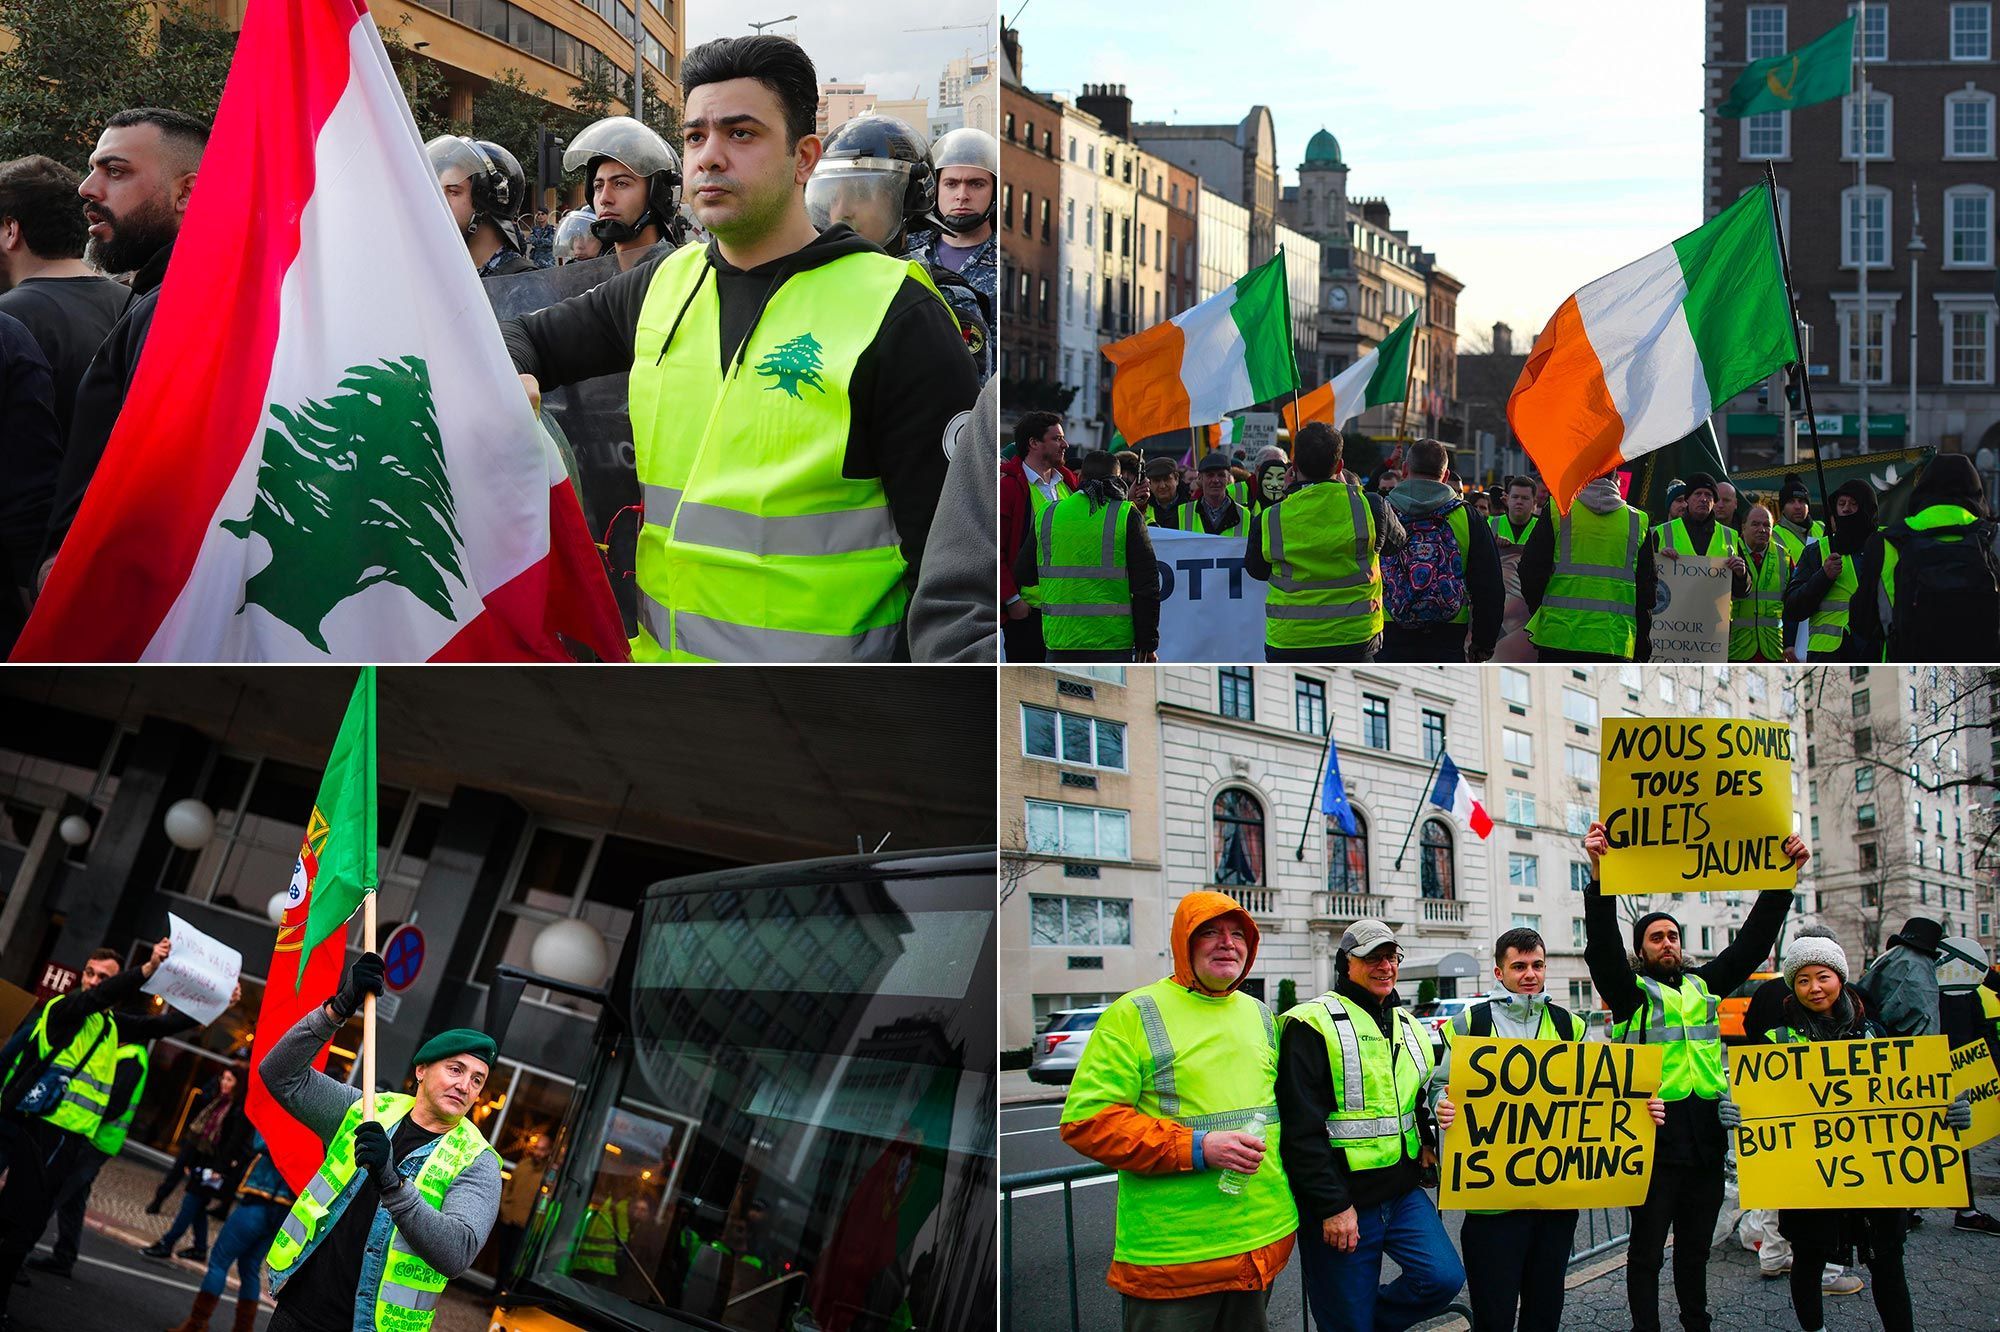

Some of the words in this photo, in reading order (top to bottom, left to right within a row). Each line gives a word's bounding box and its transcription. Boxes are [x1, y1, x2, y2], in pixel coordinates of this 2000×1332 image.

[1652, 620, 1704, 633] ONOUR
[1607, 724, 1706, 762] NOUS
[1716, 723, 1790, 761] SOMMES
[1631, 770, 1700, 799] TOUS
[1715, 770, 1763, 796] DES
[1604, 802, 1710, 849] GILETS
[1681, 835, 1795, 880] JAUNES
[1466, 1043, 1652, 1099] SOCIAL
[1734, 1045, 1810, 1086] NOT
[1820, 1039, 1914, 1077] LEFT
[1951, 1042, 1990, 1073] HANGE
[1808, 1079, 1853, 1108] VS
[1867, 1072, 1952, 1104] RIGHT
[1967, 1077, 2000, 1104] ANGE
[1463, 1100, 1637, 1147] WINTER
[1737, 1122, 1796, 1157] BUT
[1814, 1111, 1961, 1149] BOTTOM
[1451, 1150, 1495, 1191] IS
[1505, 1144, 1643, 1187] COMING
[1815, 1154, 1864, 1188] VS
[1872, 1144, 1959, 1185] TOP
